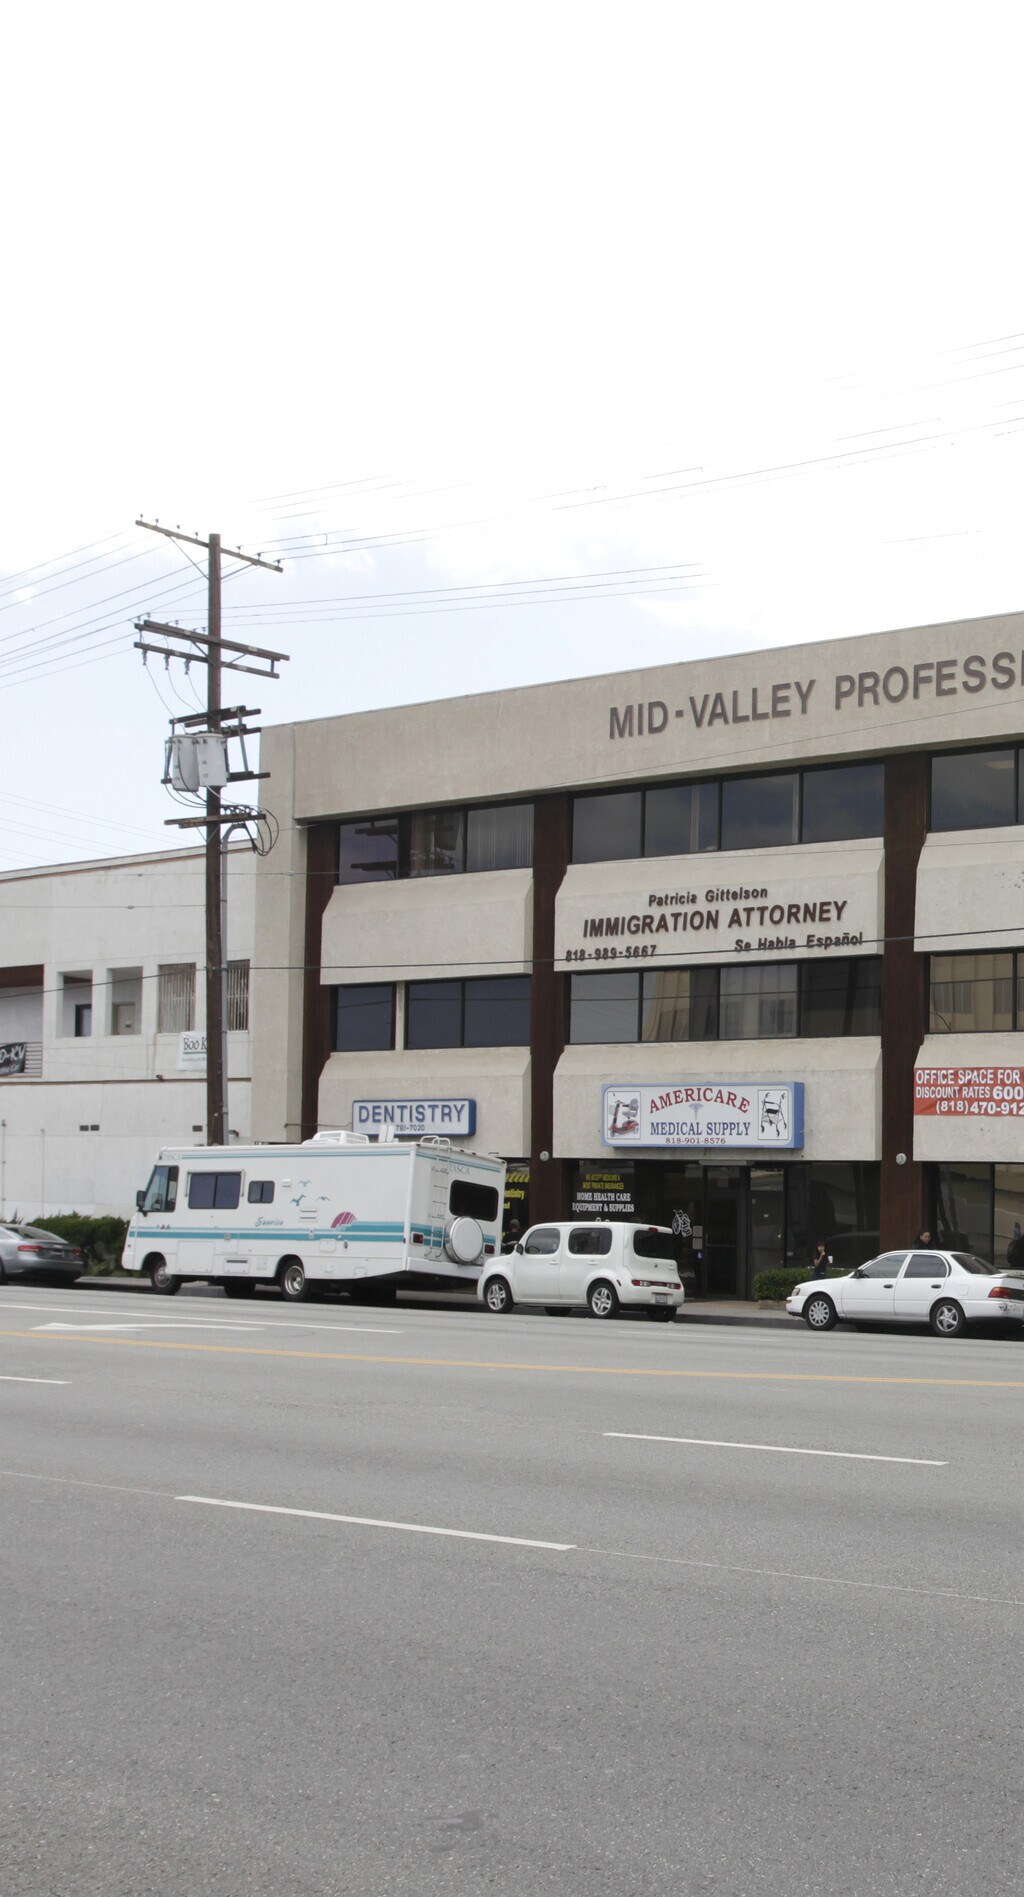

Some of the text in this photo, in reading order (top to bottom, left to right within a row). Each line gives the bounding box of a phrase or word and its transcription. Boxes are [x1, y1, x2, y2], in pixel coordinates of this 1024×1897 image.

[609, 679, 816, 740] MID-VALLEY
[648, 887, 768, 907] Patricia Gittelson
[583, 901, 848, 938] IMMIGRATION ATTORNEY
[734, 932, 863, 953] Se Habla Español
[565, 944, 657, 962] 818-989-5667
[916, 1070, 954, 1085] OFFICE
[958, 1069, 994, 1084] SPACE
[997, 1069, 1020, 1084] FOR
[650, 1087, 750, 1114] AMERICARE
[915, 1086, 959, 1099] DISCOUNT
[962, 1086, 991, 1098] RATES
[992, 1086, 1024, 1100] 600
[358, 1104, 466, 1122] DENTISTRY
[650, 1122, 751, 1136] MEDICAL SUPPLY
[665, 1137, 726, 1145] 818-901-8576
[576, 1192, 631, 1201] HOME HEALTH CARE
[609, 1204, 635, 1212] SUPPLIES
